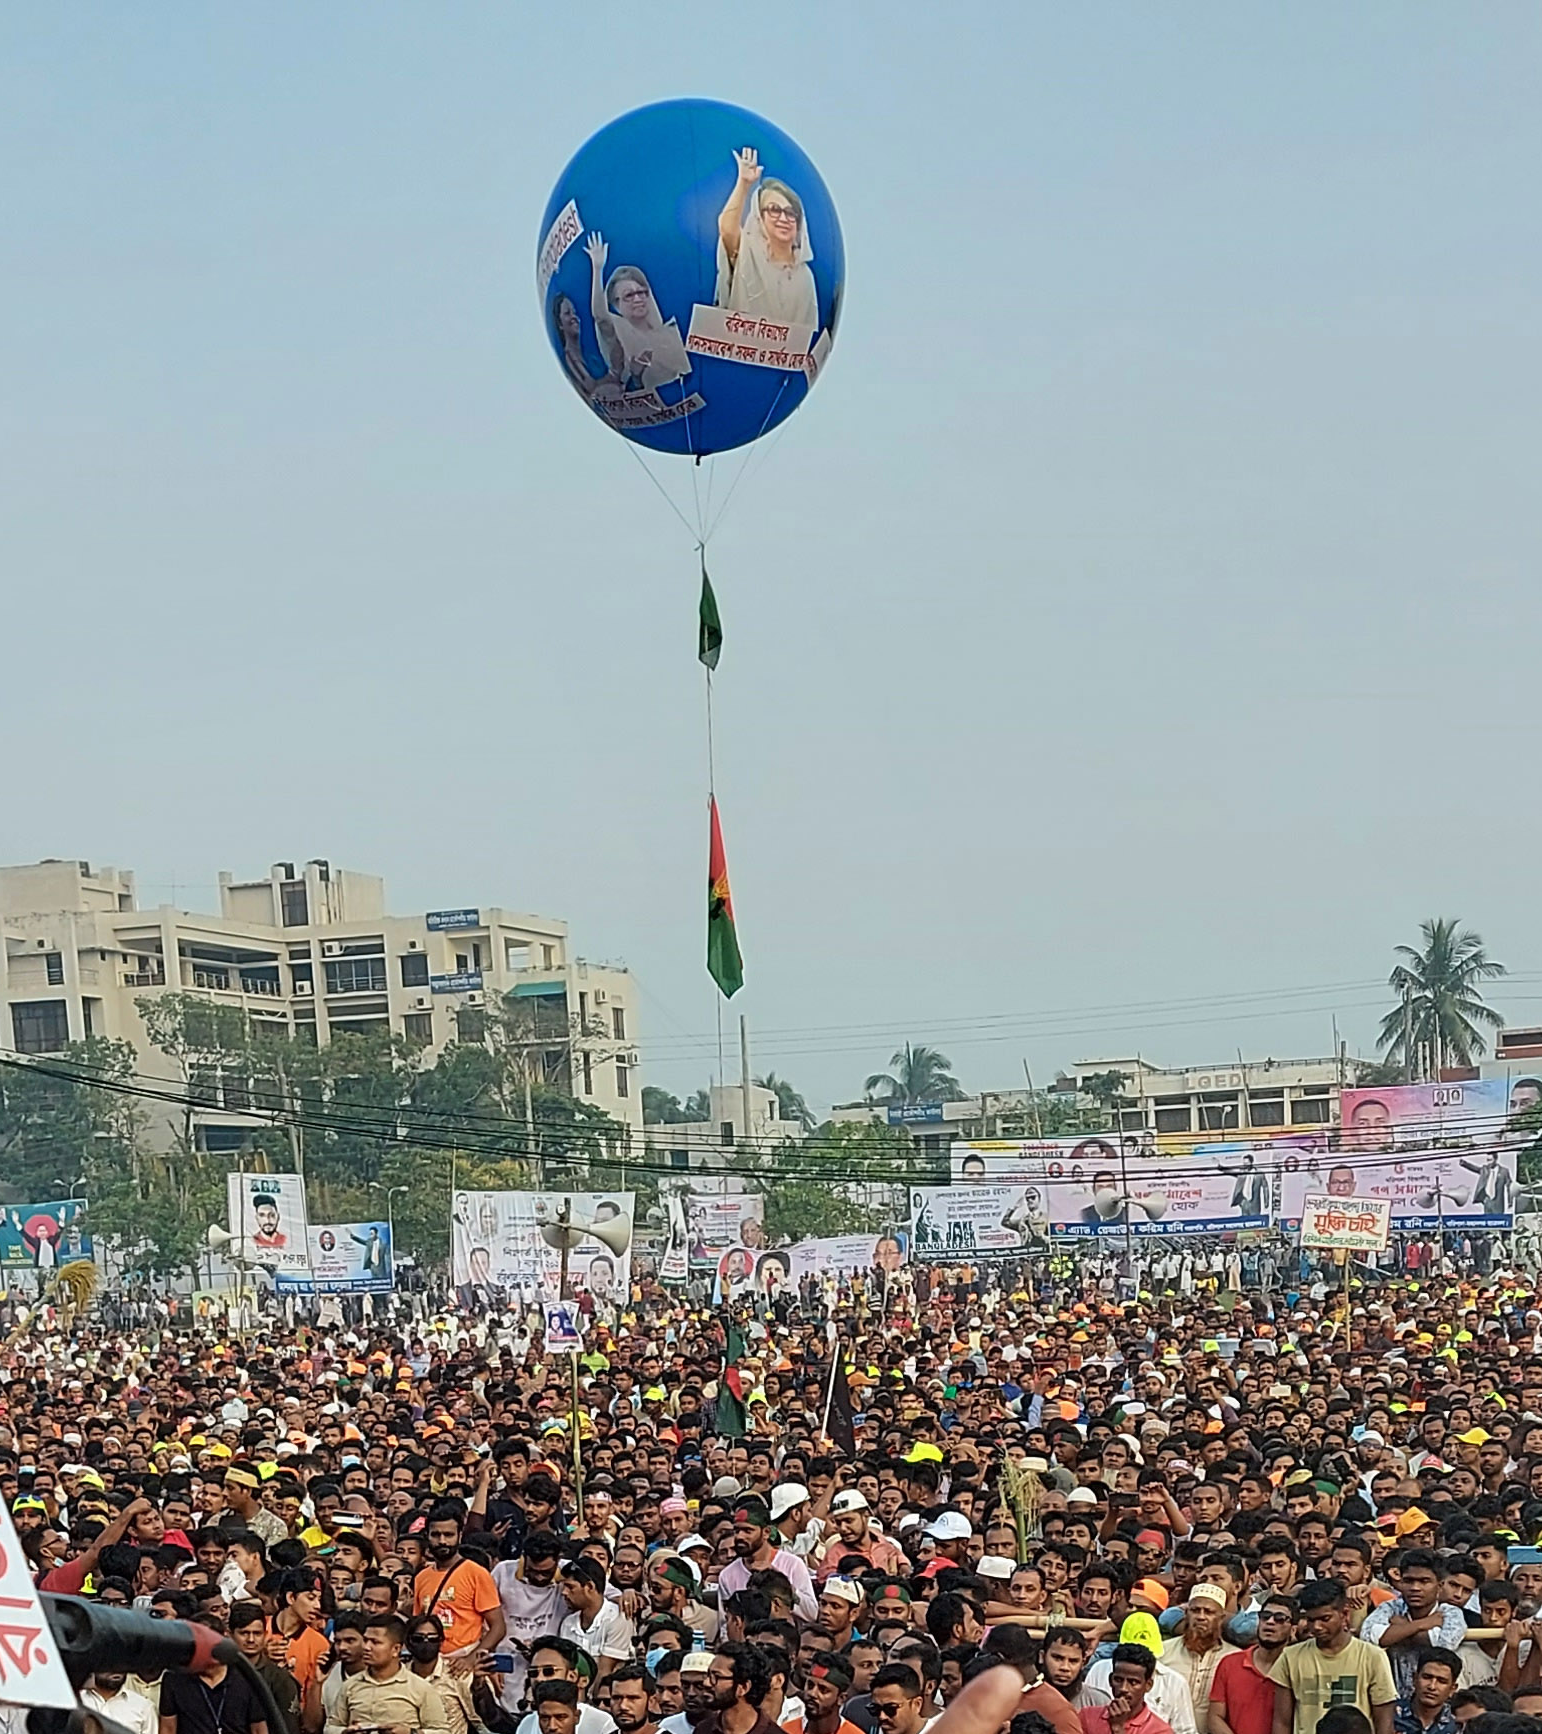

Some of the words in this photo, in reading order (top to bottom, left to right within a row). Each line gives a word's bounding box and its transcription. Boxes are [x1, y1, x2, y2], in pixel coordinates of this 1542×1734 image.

[1171, 1200, 1200, 1211] হোক
[1166, 1221, 1184, 1233] রনি
[915, 1240, 977, 1251] BANGLADESH
